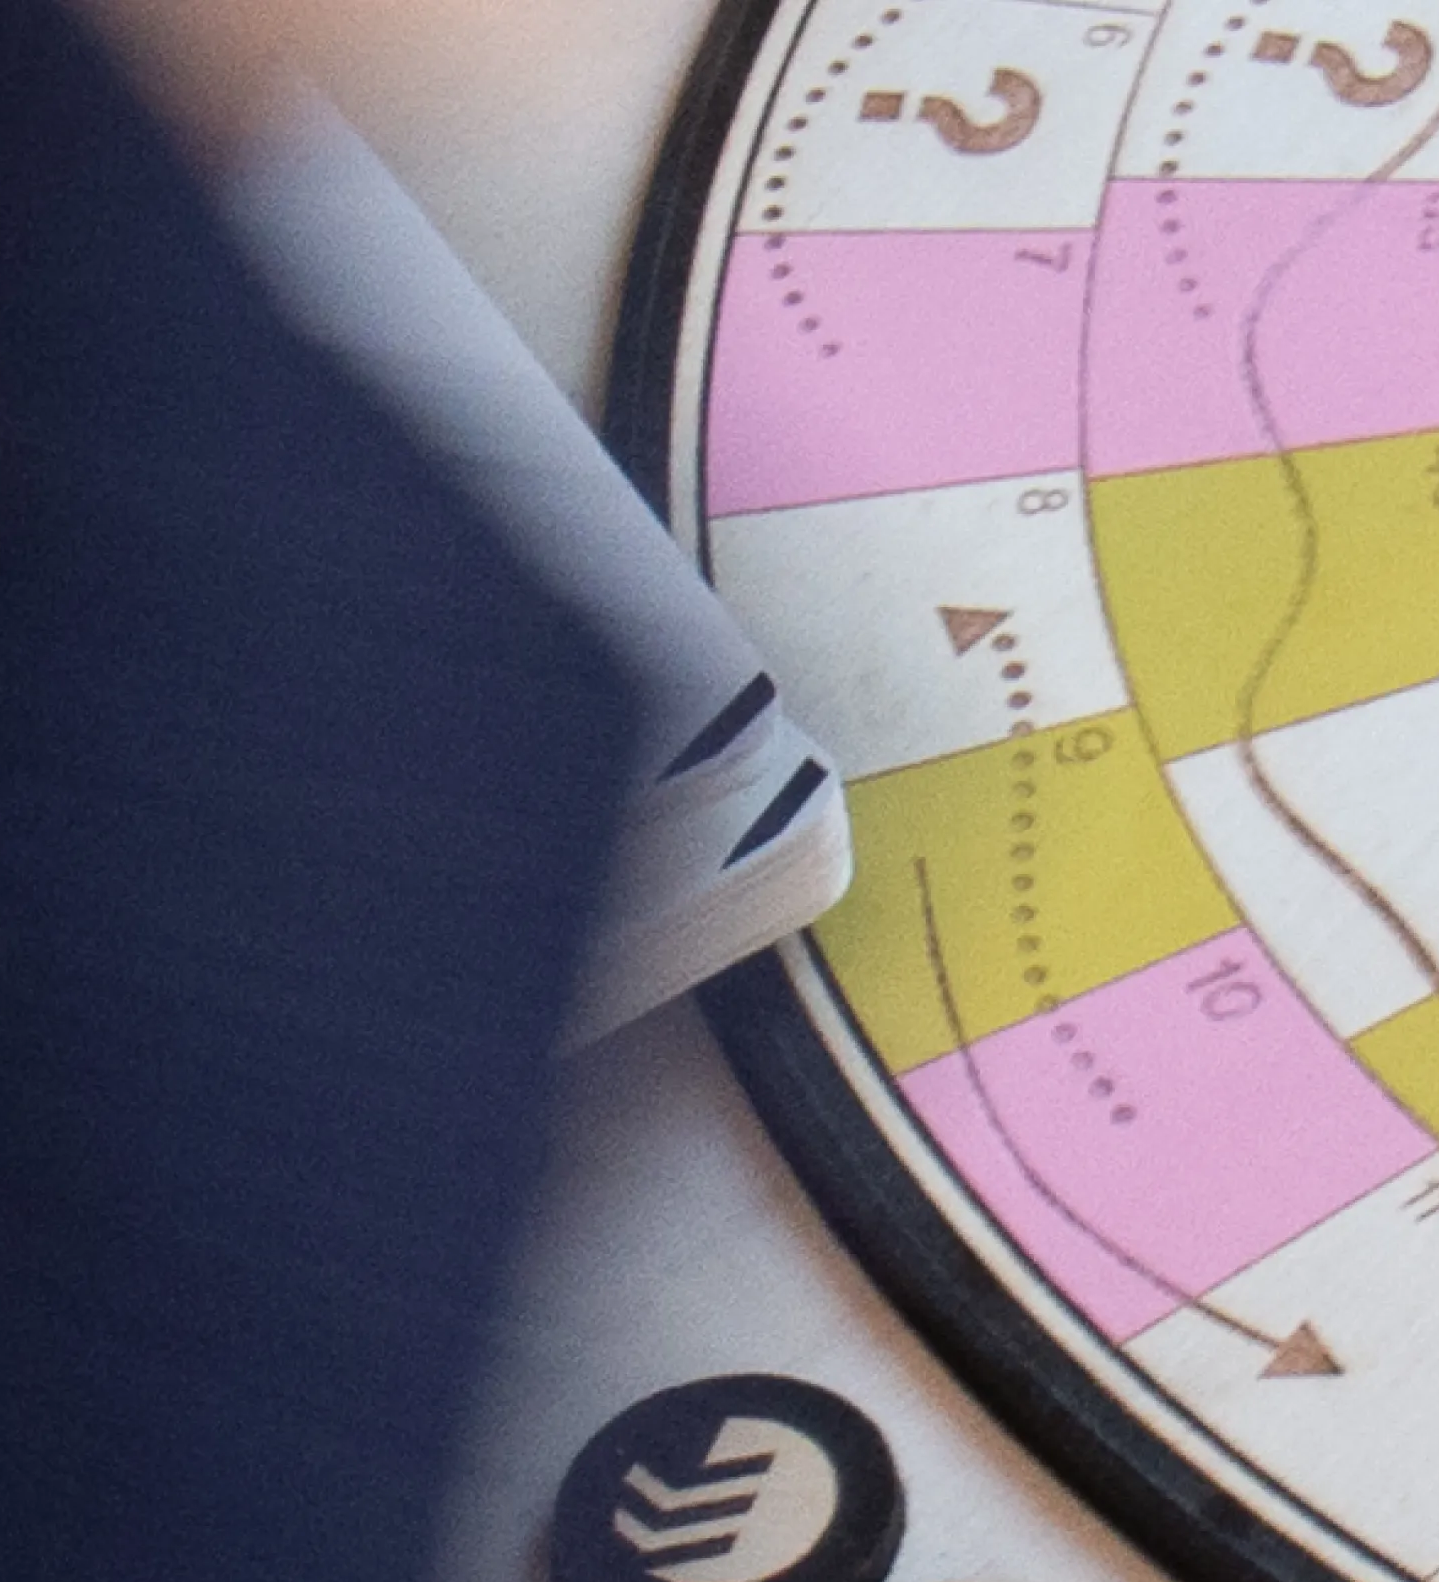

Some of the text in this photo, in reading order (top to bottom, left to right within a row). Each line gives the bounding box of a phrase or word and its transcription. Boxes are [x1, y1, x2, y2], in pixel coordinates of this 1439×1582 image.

[1013, 241, 1073, 274] 7
[1015, 487, 1070, 517] 8
[1053, 727, 1114, 765] 9
[1184, 957, 1262, 1022] 10
